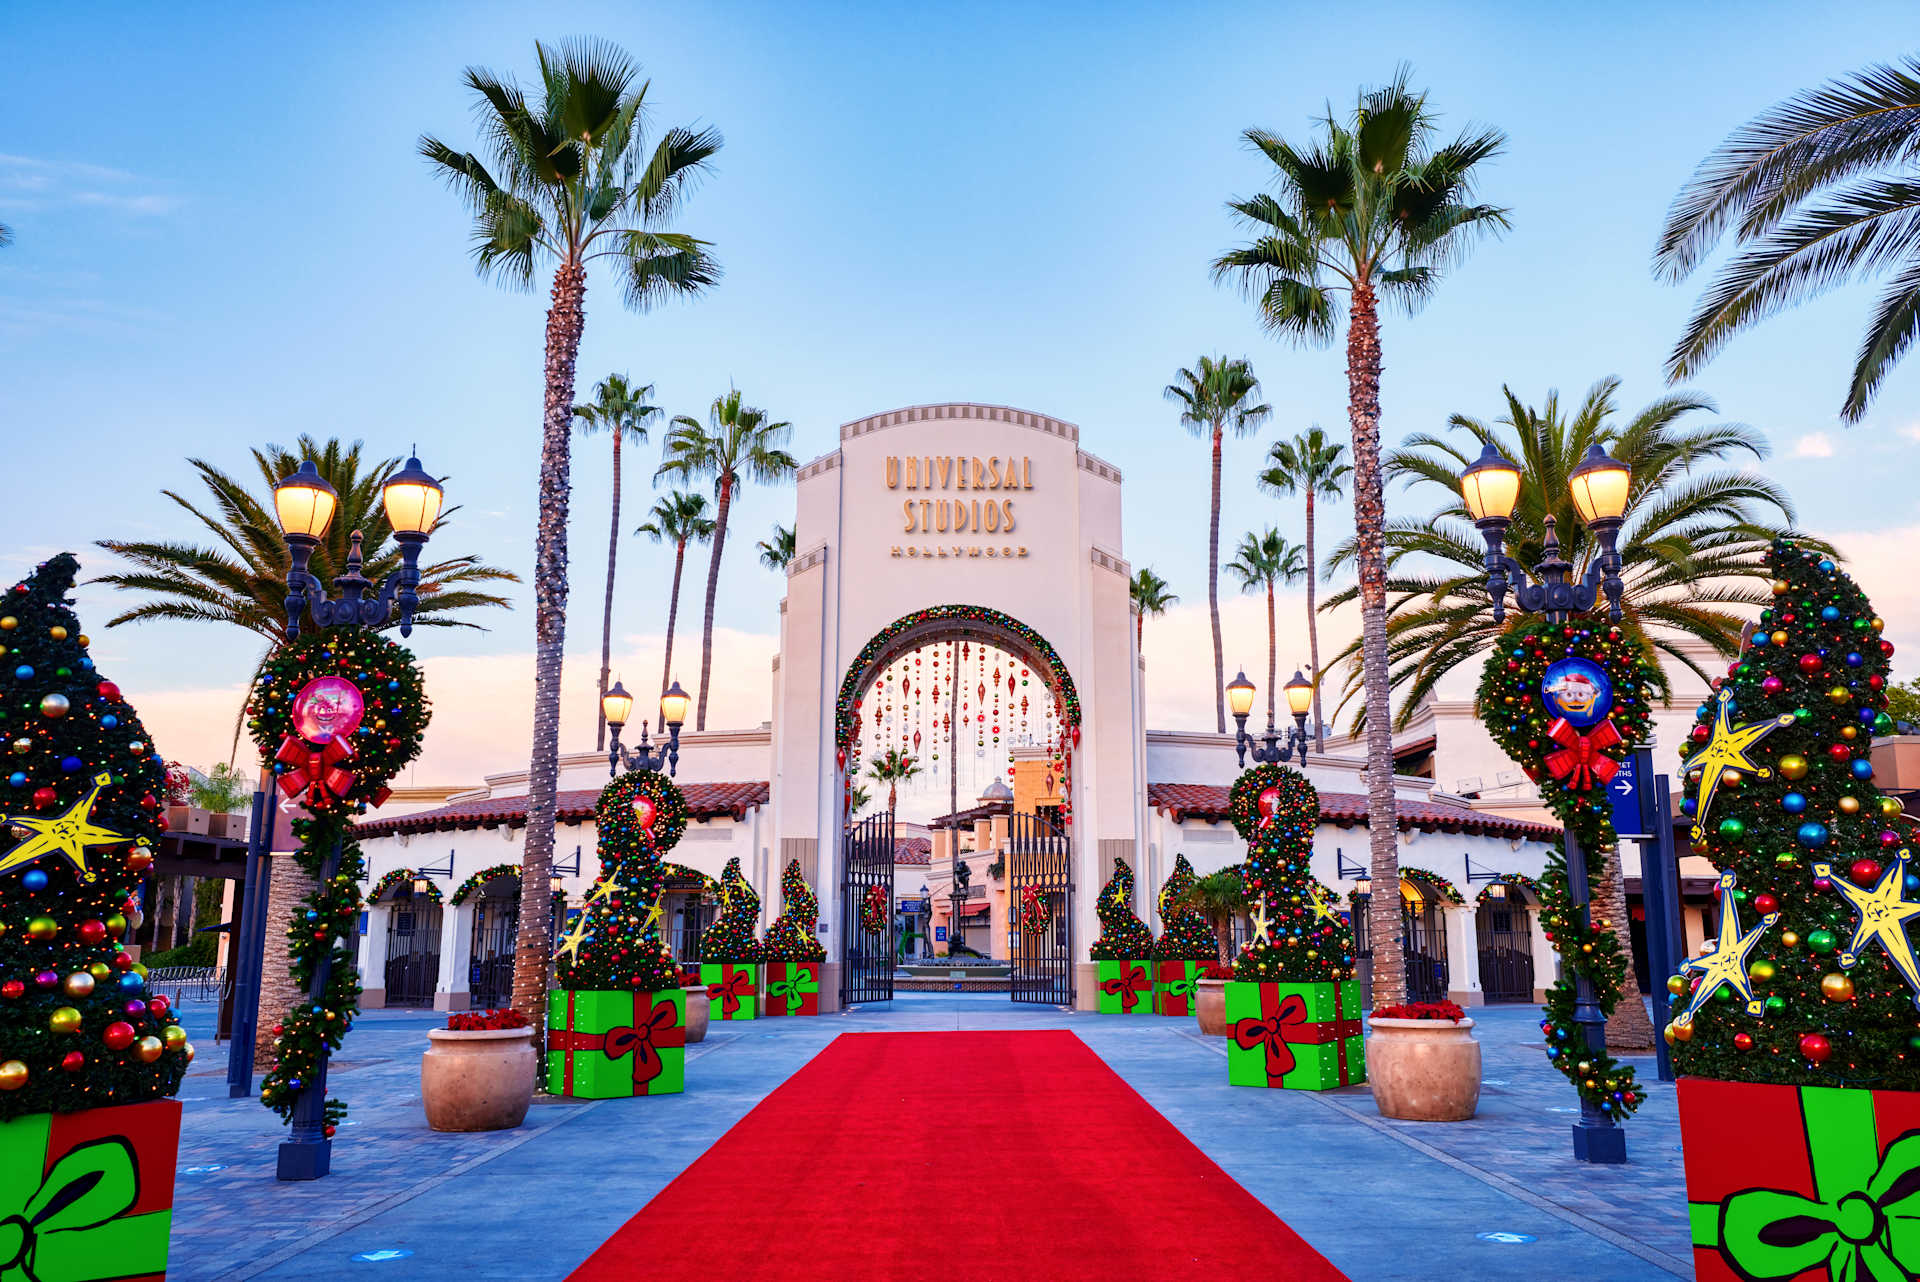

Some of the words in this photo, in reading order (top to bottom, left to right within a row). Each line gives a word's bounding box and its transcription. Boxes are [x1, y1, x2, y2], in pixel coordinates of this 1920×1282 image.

[886, 456, 1034, 490] UNIVERSAL
[903, 499, 1016, 533] STUDIOS
[890, 546, 1029, 557] HOLLYWOOD
